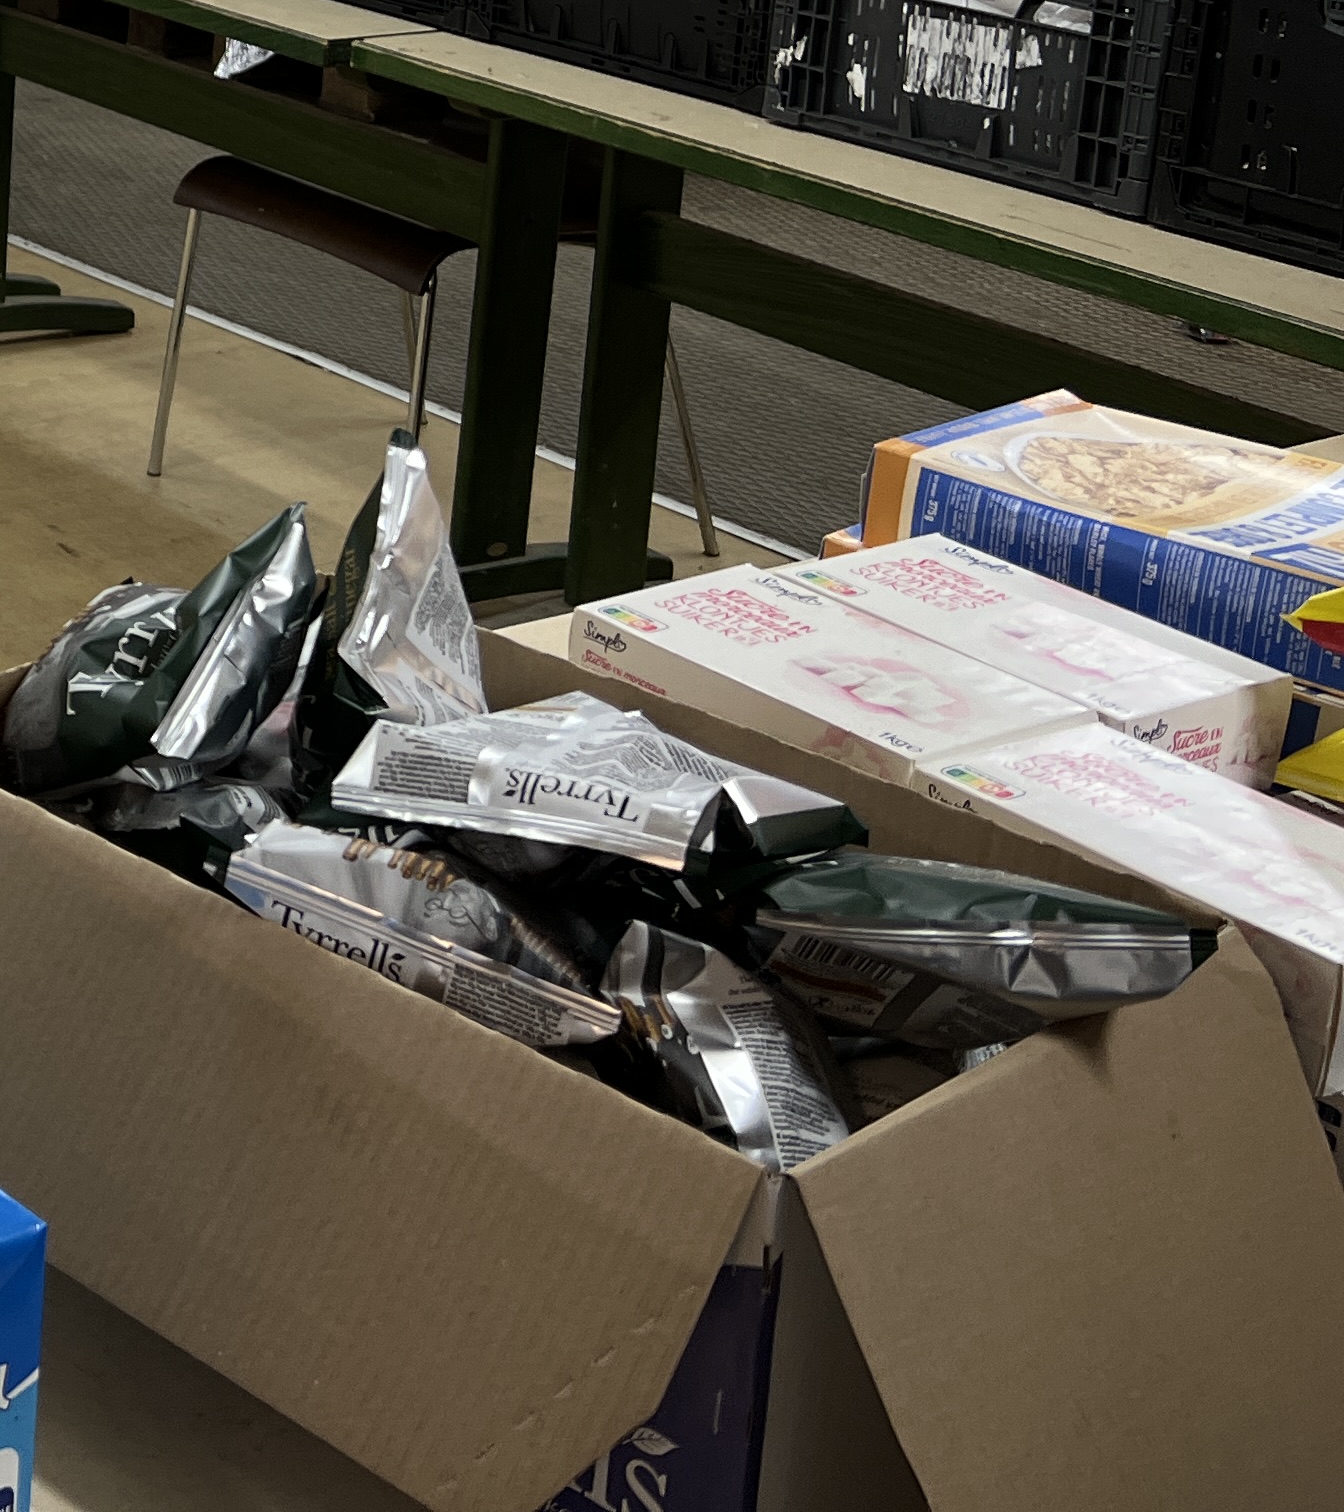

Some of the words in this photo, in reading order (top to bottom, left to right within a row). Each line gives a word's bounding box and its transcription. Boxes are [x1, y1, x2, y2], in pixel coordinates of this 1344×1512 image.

[652, 592, 740, 640] SUIKER
[670, 586, 789, 647] KLONTJES
[582, 648, 611, 672] Sucre
[1167, 727, 1209, 755] Sucre
